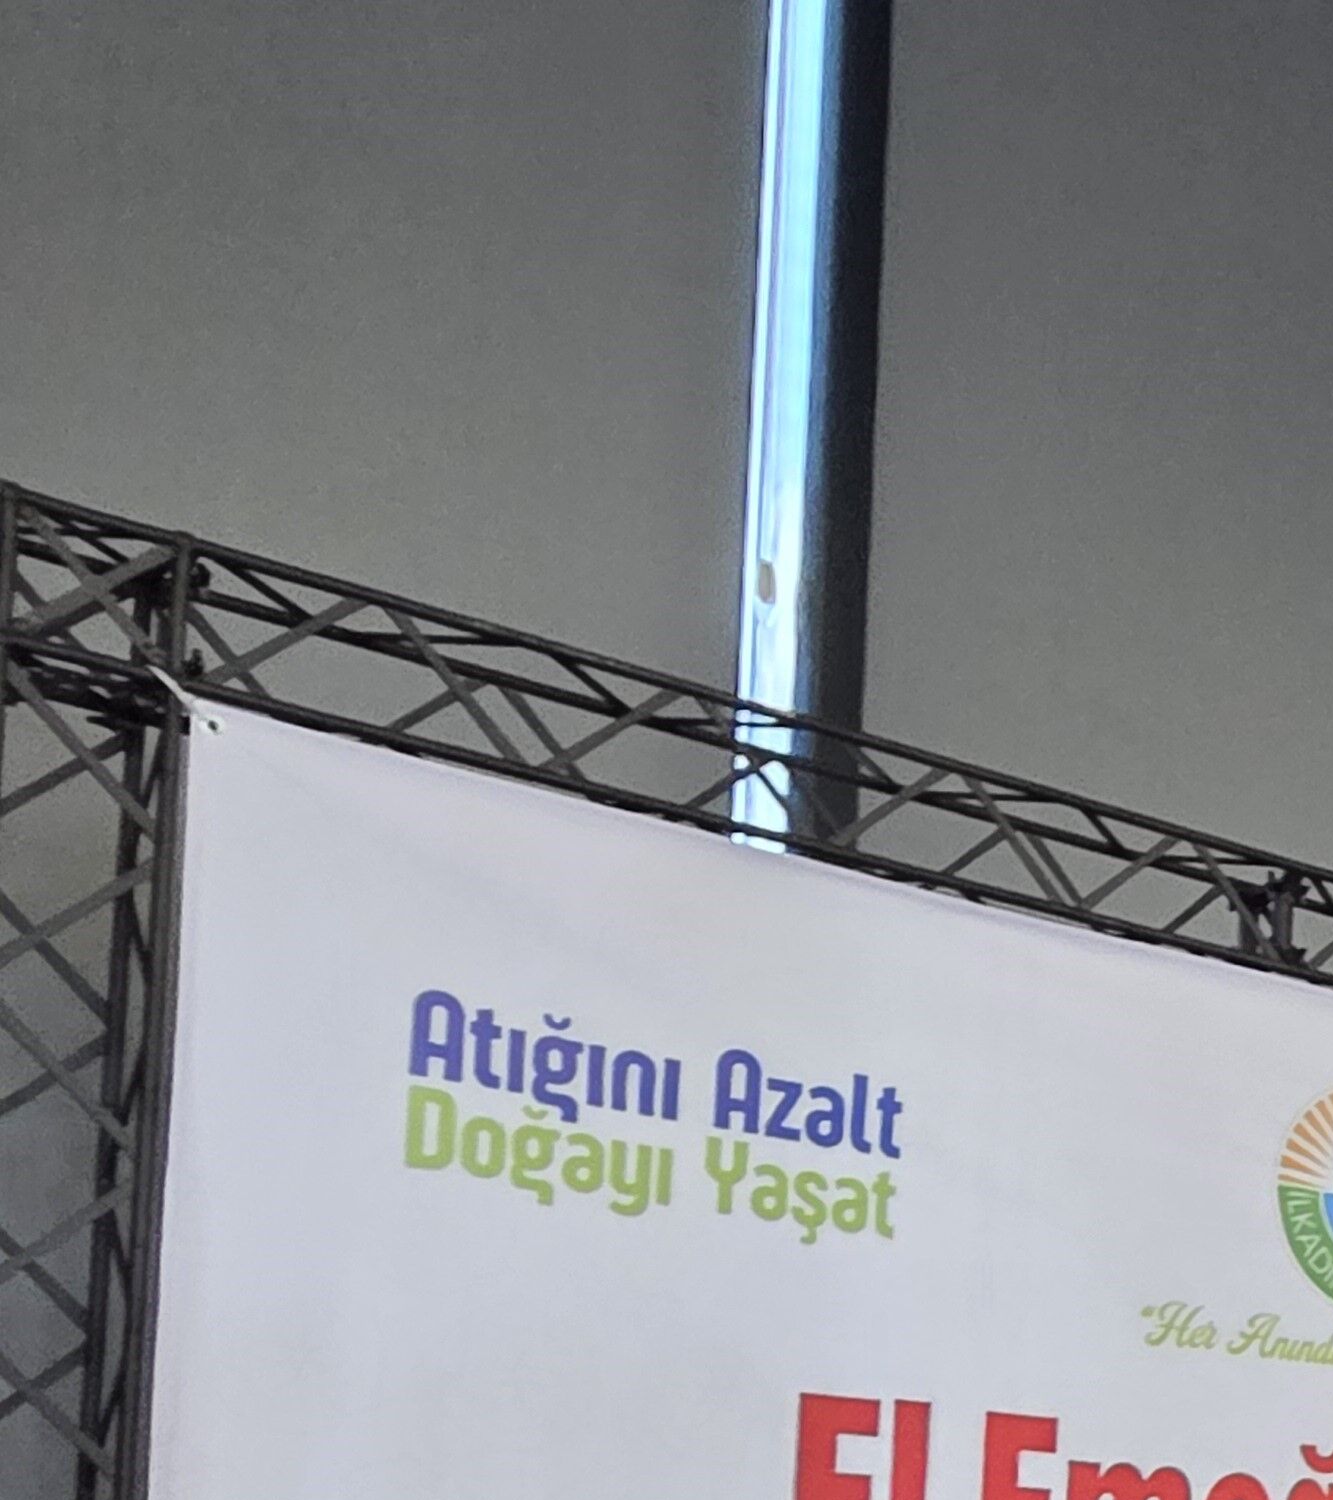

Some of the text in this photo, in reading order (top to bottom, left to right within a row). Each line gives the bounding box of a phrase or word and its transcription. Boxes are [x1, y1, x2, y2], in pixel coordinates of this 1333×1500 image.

[409, 989, 904, 1159] Atığını Azalt
[404, 1084, 897, 1245] Doğayı Yaşat
